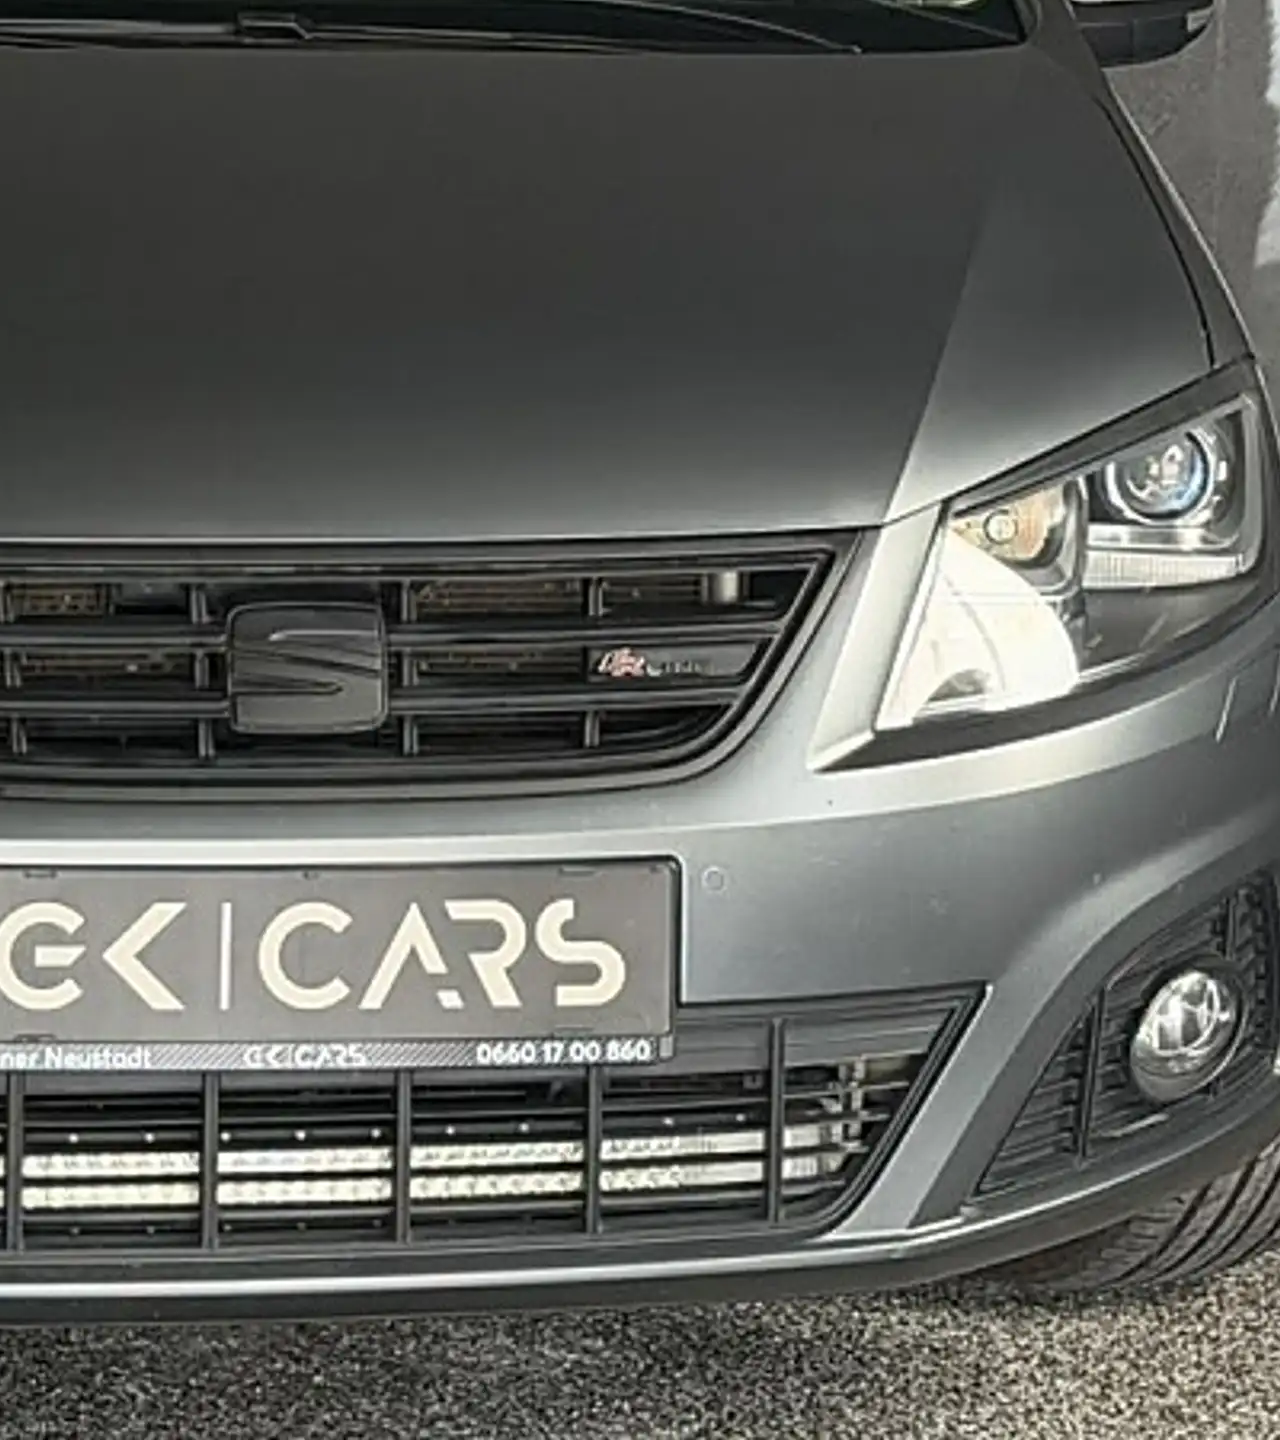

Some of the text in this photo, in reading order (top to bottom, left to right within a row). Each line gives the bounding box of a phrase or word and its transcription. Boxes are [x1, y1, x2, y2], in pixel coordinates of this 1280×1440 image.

[258, 899, 625, 1009] CARS
[45, 1046, 152, 1068] Neustadt
[477, 1039, 650, 1063] 0660 17 00 860
